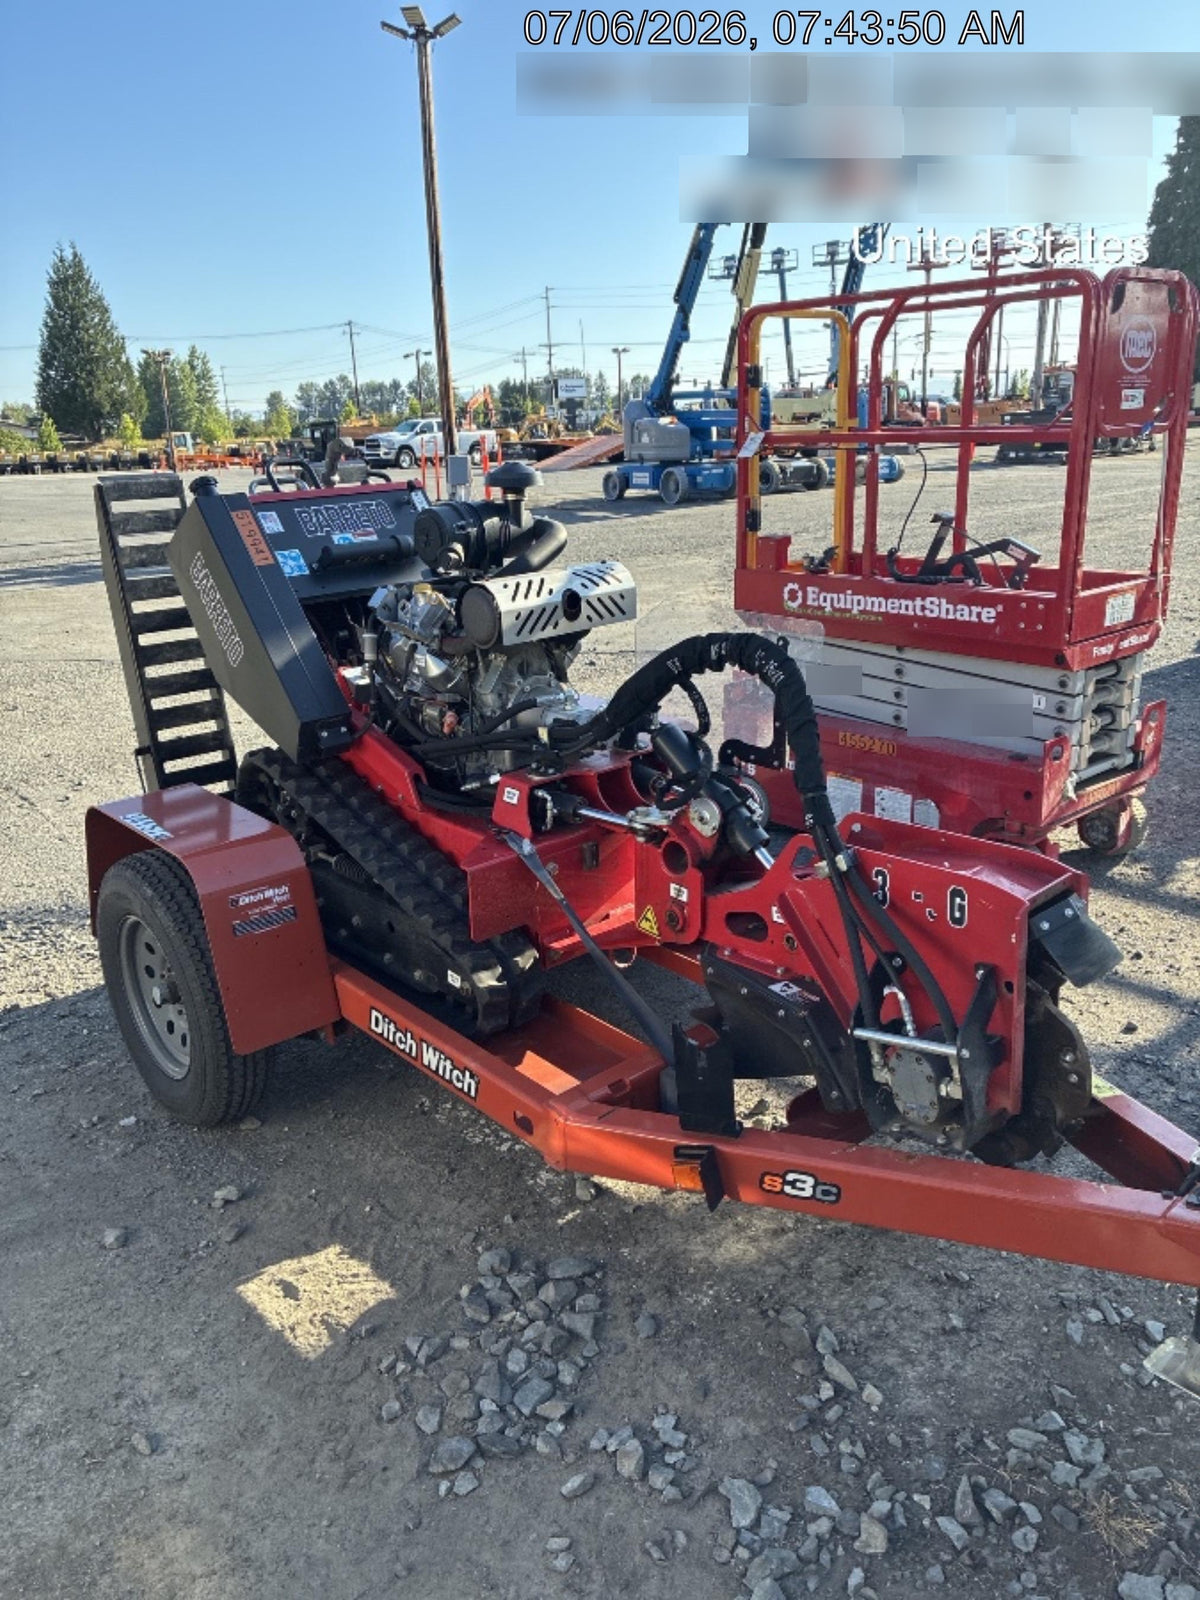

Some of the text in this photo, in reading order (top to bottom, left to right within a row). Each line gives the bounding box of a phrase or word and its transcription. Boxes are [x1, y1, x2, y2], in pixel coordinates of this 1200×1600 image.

[294, 499, 397, 538] BARRETO
[189, 552, 245, 668] BARRETO
[806, 586, 999, 624] EquipmentShare
[369, 1006, 479, 1100] Ditch Witch
